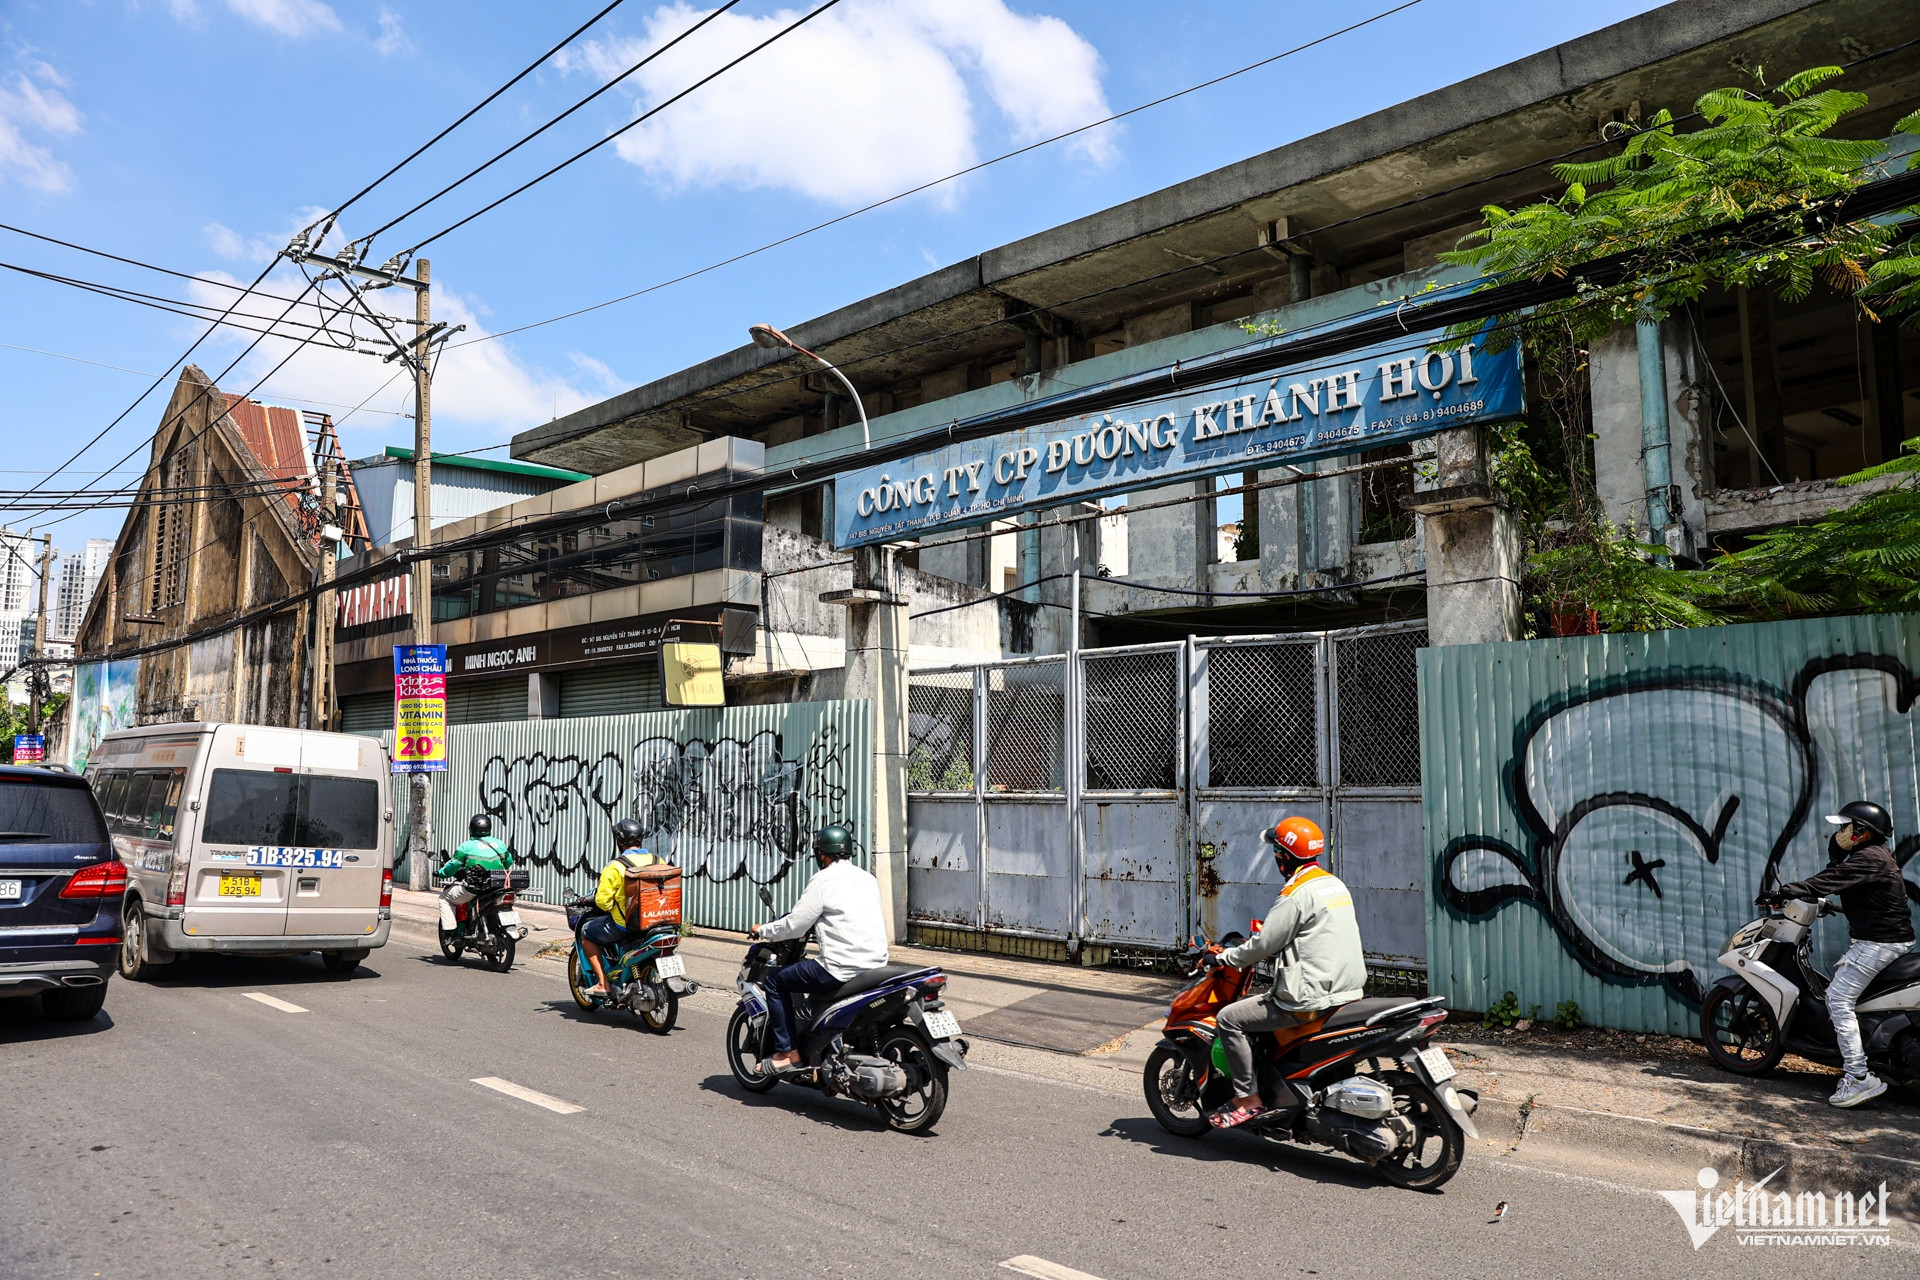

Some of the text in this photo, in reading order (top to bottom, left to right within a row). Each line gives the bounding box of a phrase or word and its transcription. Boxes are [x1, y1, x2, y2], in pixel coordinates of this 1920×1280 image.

[857, 337, 1479, 517] CÔNG TY CP ĐƯỜNG KHÁNH HỘI
[1317, 425, 1360, 441] 9404675
[340, 573, 411, 628] YAMAHA
[417, 656, 438, 664] THUỐC
[465, 653, 486, 670] MINH
[487, 649, 514, 670] NGỌC
[516, 646, 536, 663] ANH
[400, 664, 442, 673] LONG CHÂU
[399, 711, 443, 719] VITAMIN
[247, 847, 343, 868] 51B-325.94
[232, 877, 250, 886] 51B
[224, 886, 256, 895] 325.94
[643, 908, 680, 918] LALAMOVE
